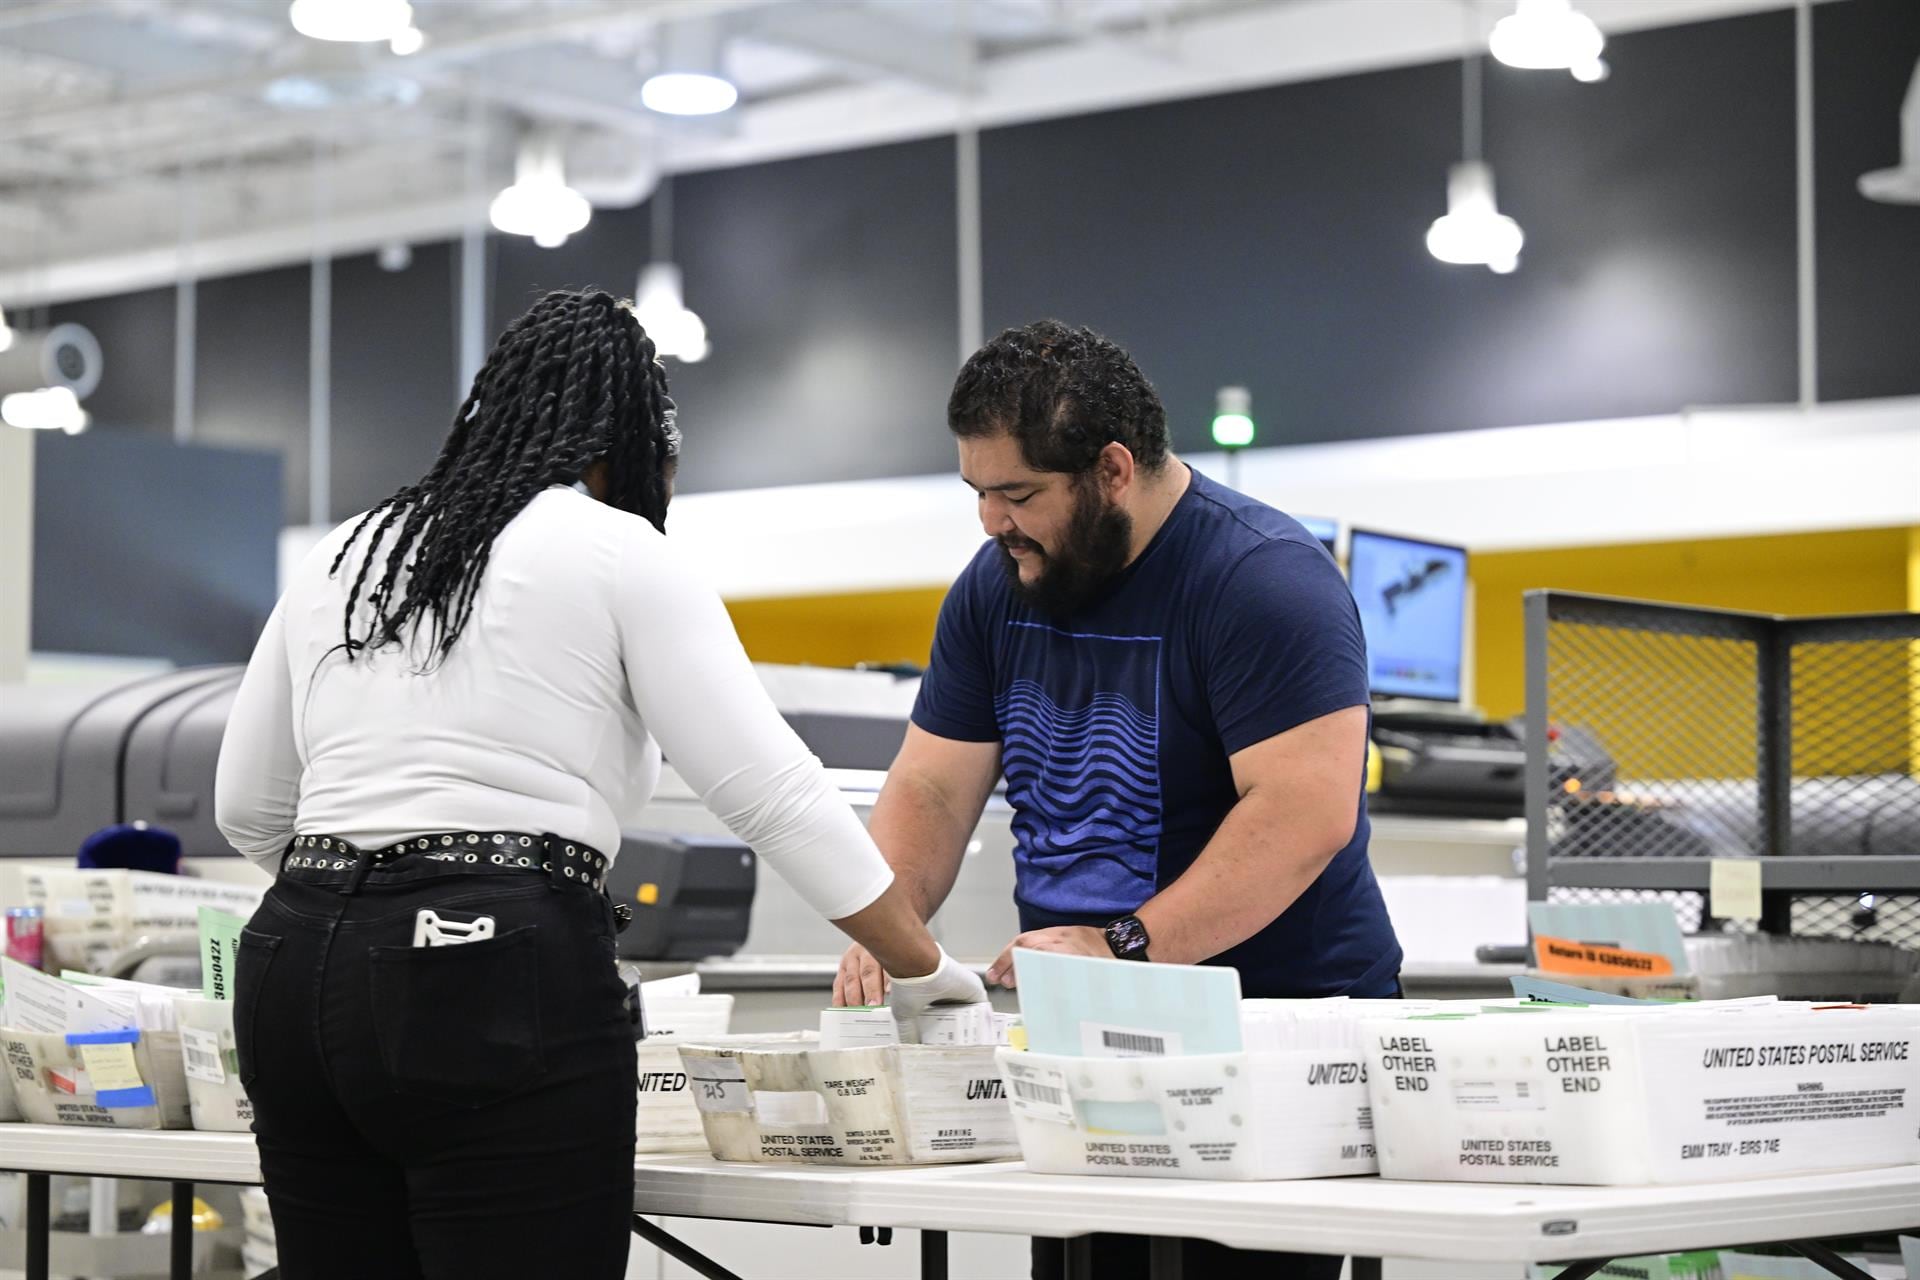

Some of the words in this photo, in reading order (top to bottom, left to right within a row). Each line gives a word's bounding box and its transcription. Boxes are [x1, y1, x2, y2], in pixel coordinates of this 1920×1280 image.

[1380, 1036, 1432, 1052] LABEL
[1544, 1036, 1608, 1052] LABEL
[1702, 1047, 1755, 1068] UNITED
[1757, 1045, 1806, 1066] STATES
[1808, 1043, 1857, 1065] POSTAL
[1859, 1041, 1909, 1062] SERVICE
[1382, 1055, 1436, 1072] OTHER
[1546, 1055, 1611, 1073] OTHER
[1308, 1062, 1358, 1085] UNITED
[824, 1080, 844, 1088] TARE
[846, 1078, 875, 1087] WEIGHT
[1395, 1075, 1429, 1091] END
[1562, 1076, 1601, 1092] END
[1797, 1081, 1824, 1093] WARNING
[851, 1087, 867, 1096] LBS
[55, 1103, 80, 1112] UNITED
[760, 1135, 795, 1145] UNITED
[796, 1136, 835, 1145] STATES
[1461, 1139, 1505, 1152] UNITED
[1507, 1140, 1552, 1152] STATES
[761, 1147, 800, 1157] POSTAL
[801, 1147, 844, 1157] SERVICE
[1085, 1142, 1126, 1153] UNITED
[1128, 1143, 1171, 1155] STATES
[1707, 1142, 1733, 1157] TRAY
[1086, 1155, 1129, 1166] POSTAL
[1131, 1156, 1180, 1168] SERVICE
[1460, 1154, 1505, 1166] POSTAL
[1507, 1155, 1559, 1167] SERVICE
